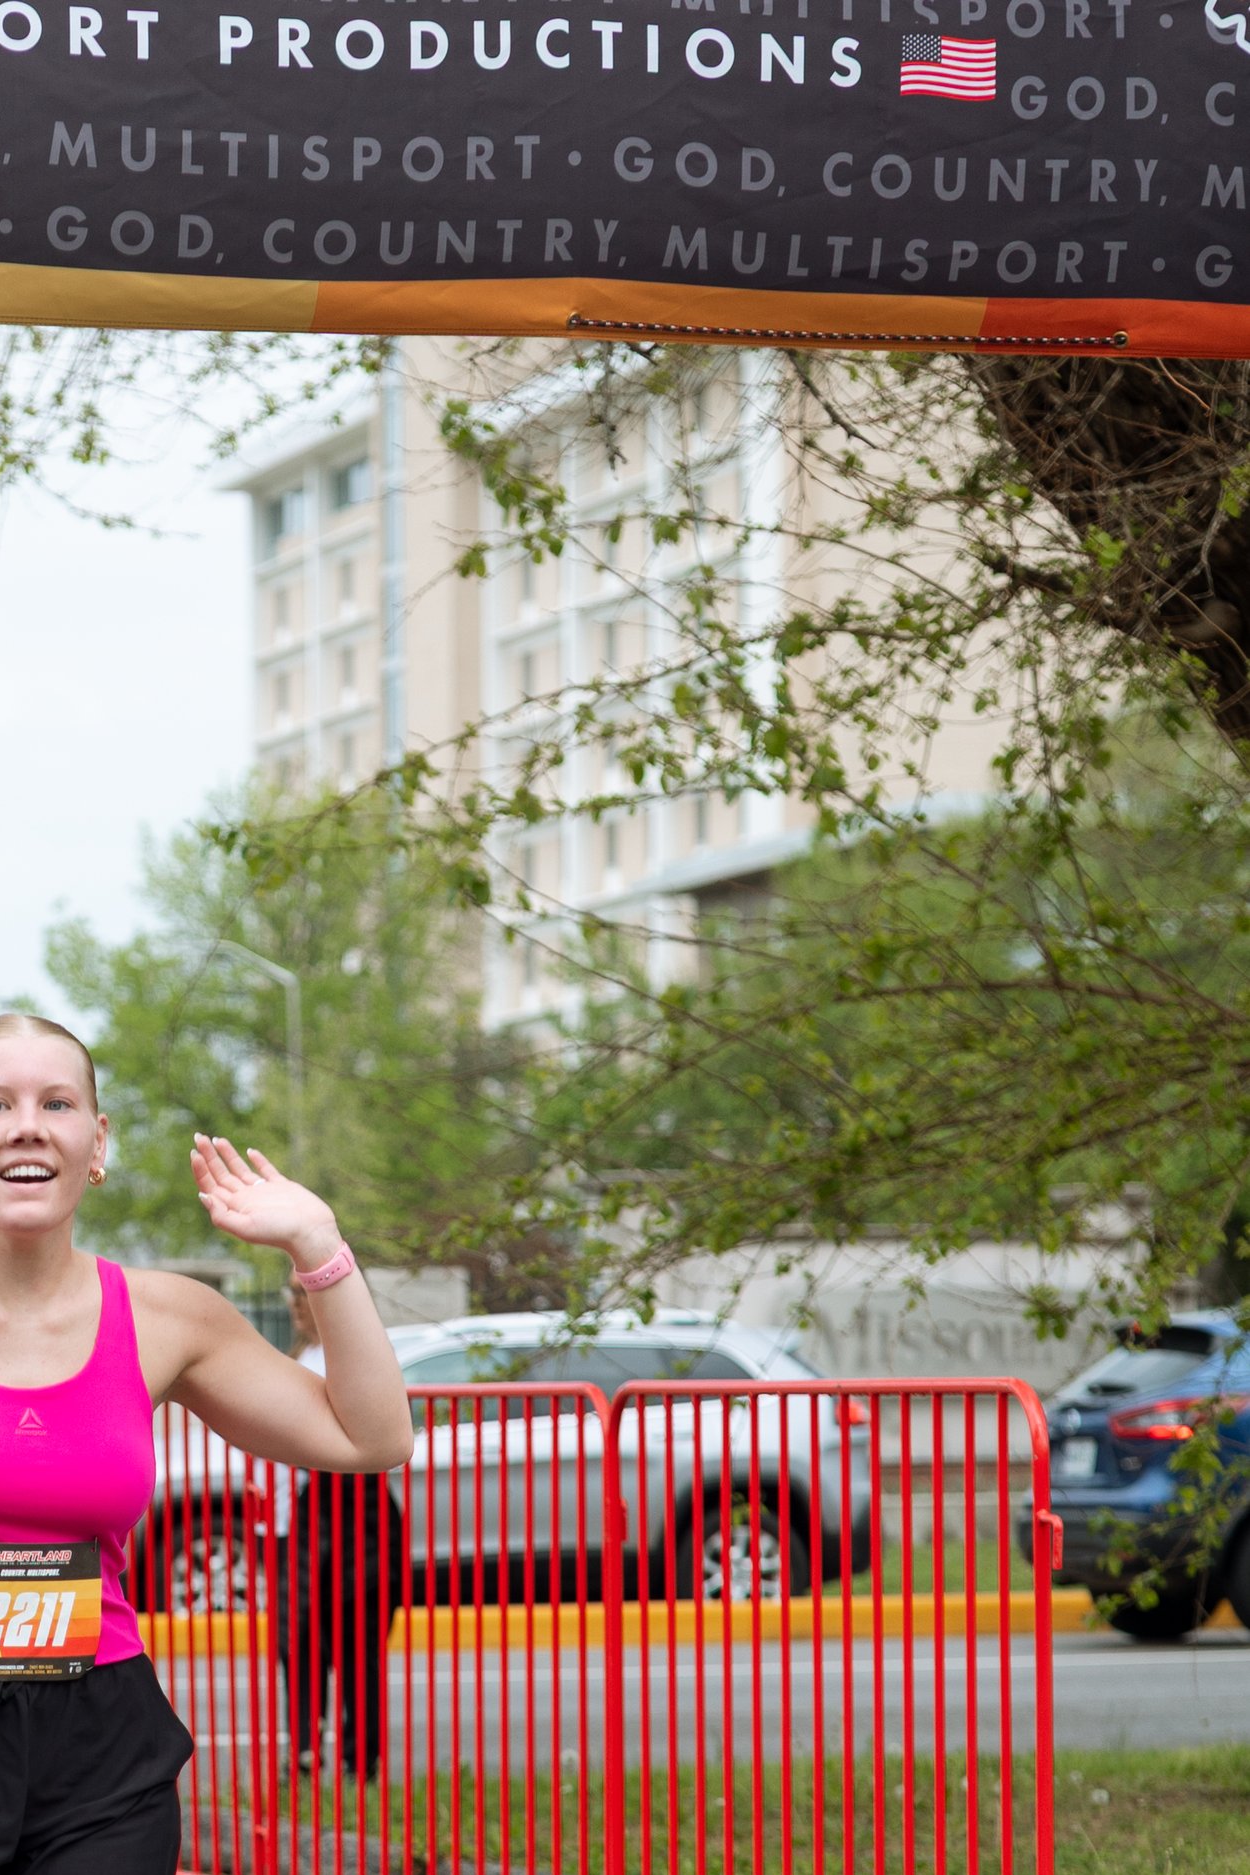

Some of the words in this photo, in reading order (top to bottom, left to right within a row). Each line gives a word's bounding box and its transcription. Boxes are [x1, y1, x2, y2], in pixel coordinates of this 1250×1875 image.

[220, 16, 861, 87] PRODUCTIONS
[1011, 76, 1168, 124] GOD,
[49, 121, 540, 182] MULTISPORT
[614, 137, 785, 197] GOD,
[823, 152, 1166, 207] COUNTRY,
[46, 206, 225, 265] GOD,
[263, 219, 625, 267] COUNTRY,
[663, 225, 1127, 283] MULTISPORT
